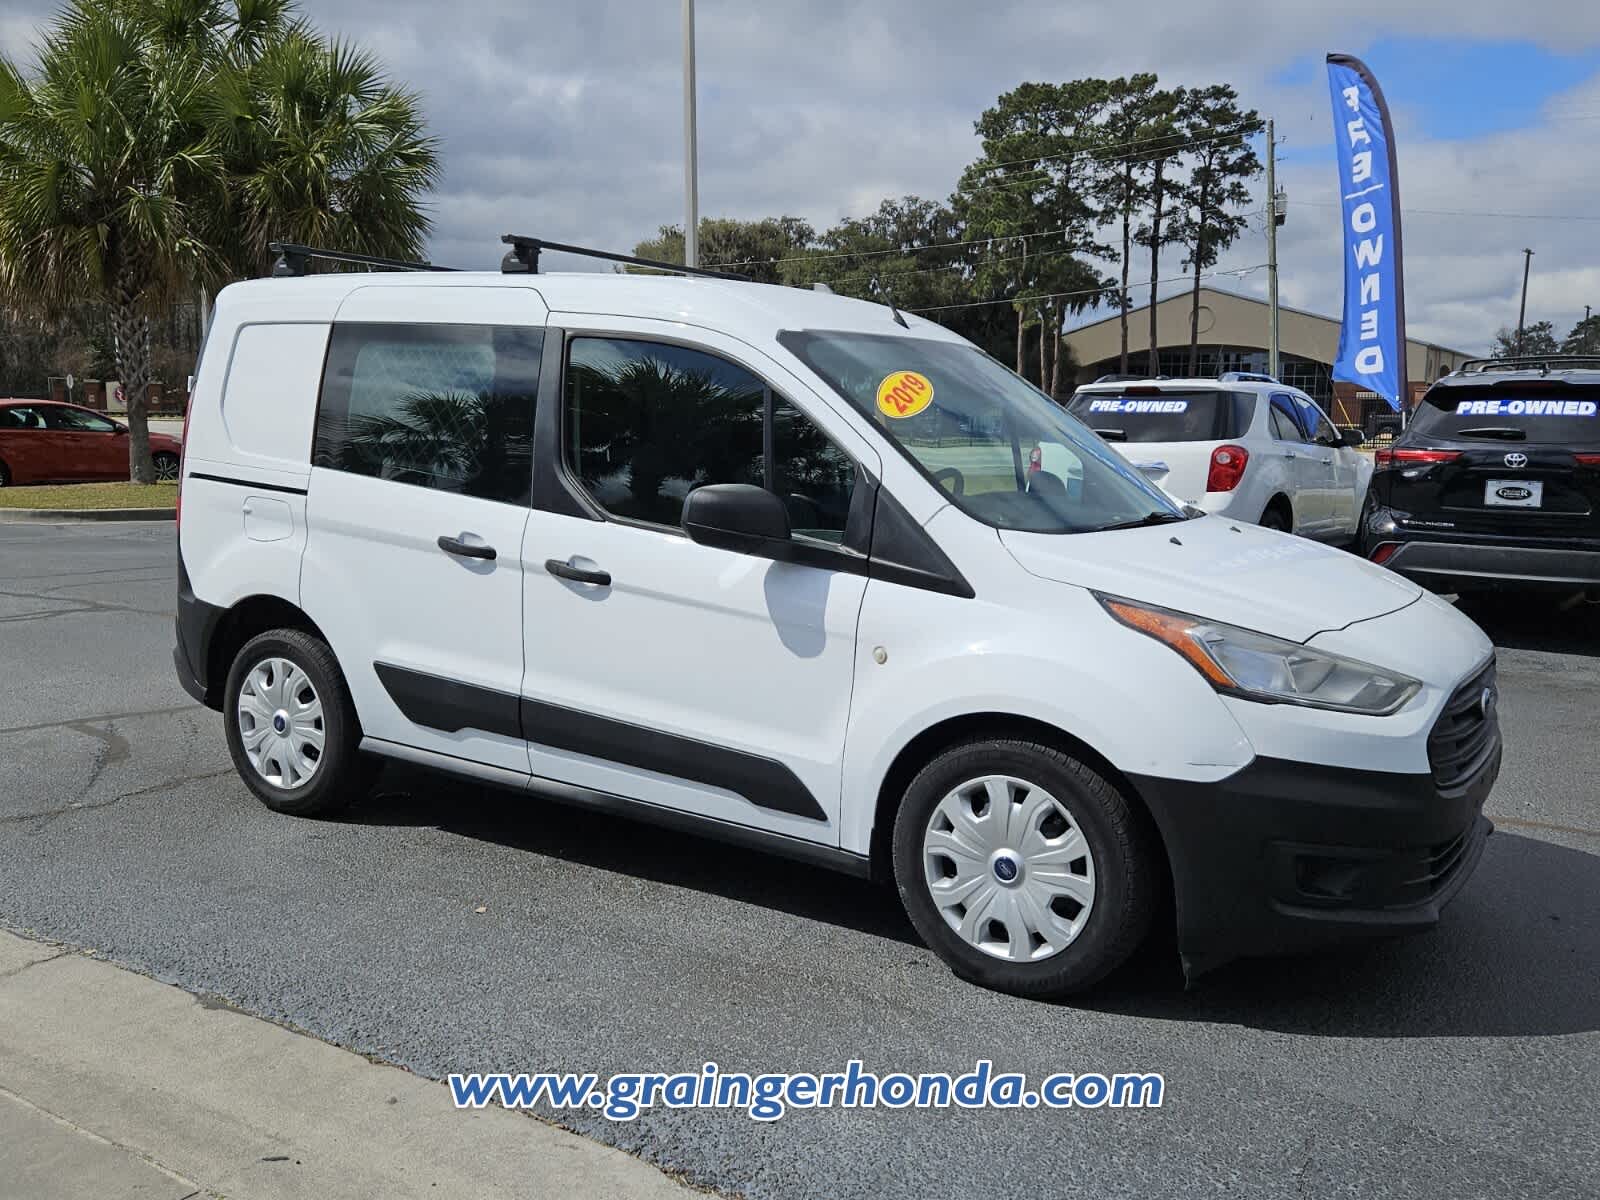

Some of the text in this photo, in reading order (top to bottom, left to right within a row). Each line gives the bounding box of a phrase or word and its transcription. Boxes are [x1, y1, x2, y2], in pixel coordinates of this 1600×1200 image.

[884, 374, 925, 413] 2019
[1089, 400, 1188, 413] PRE-OWNED
[1455, 400, 1597, 416] PRE-OWNED
